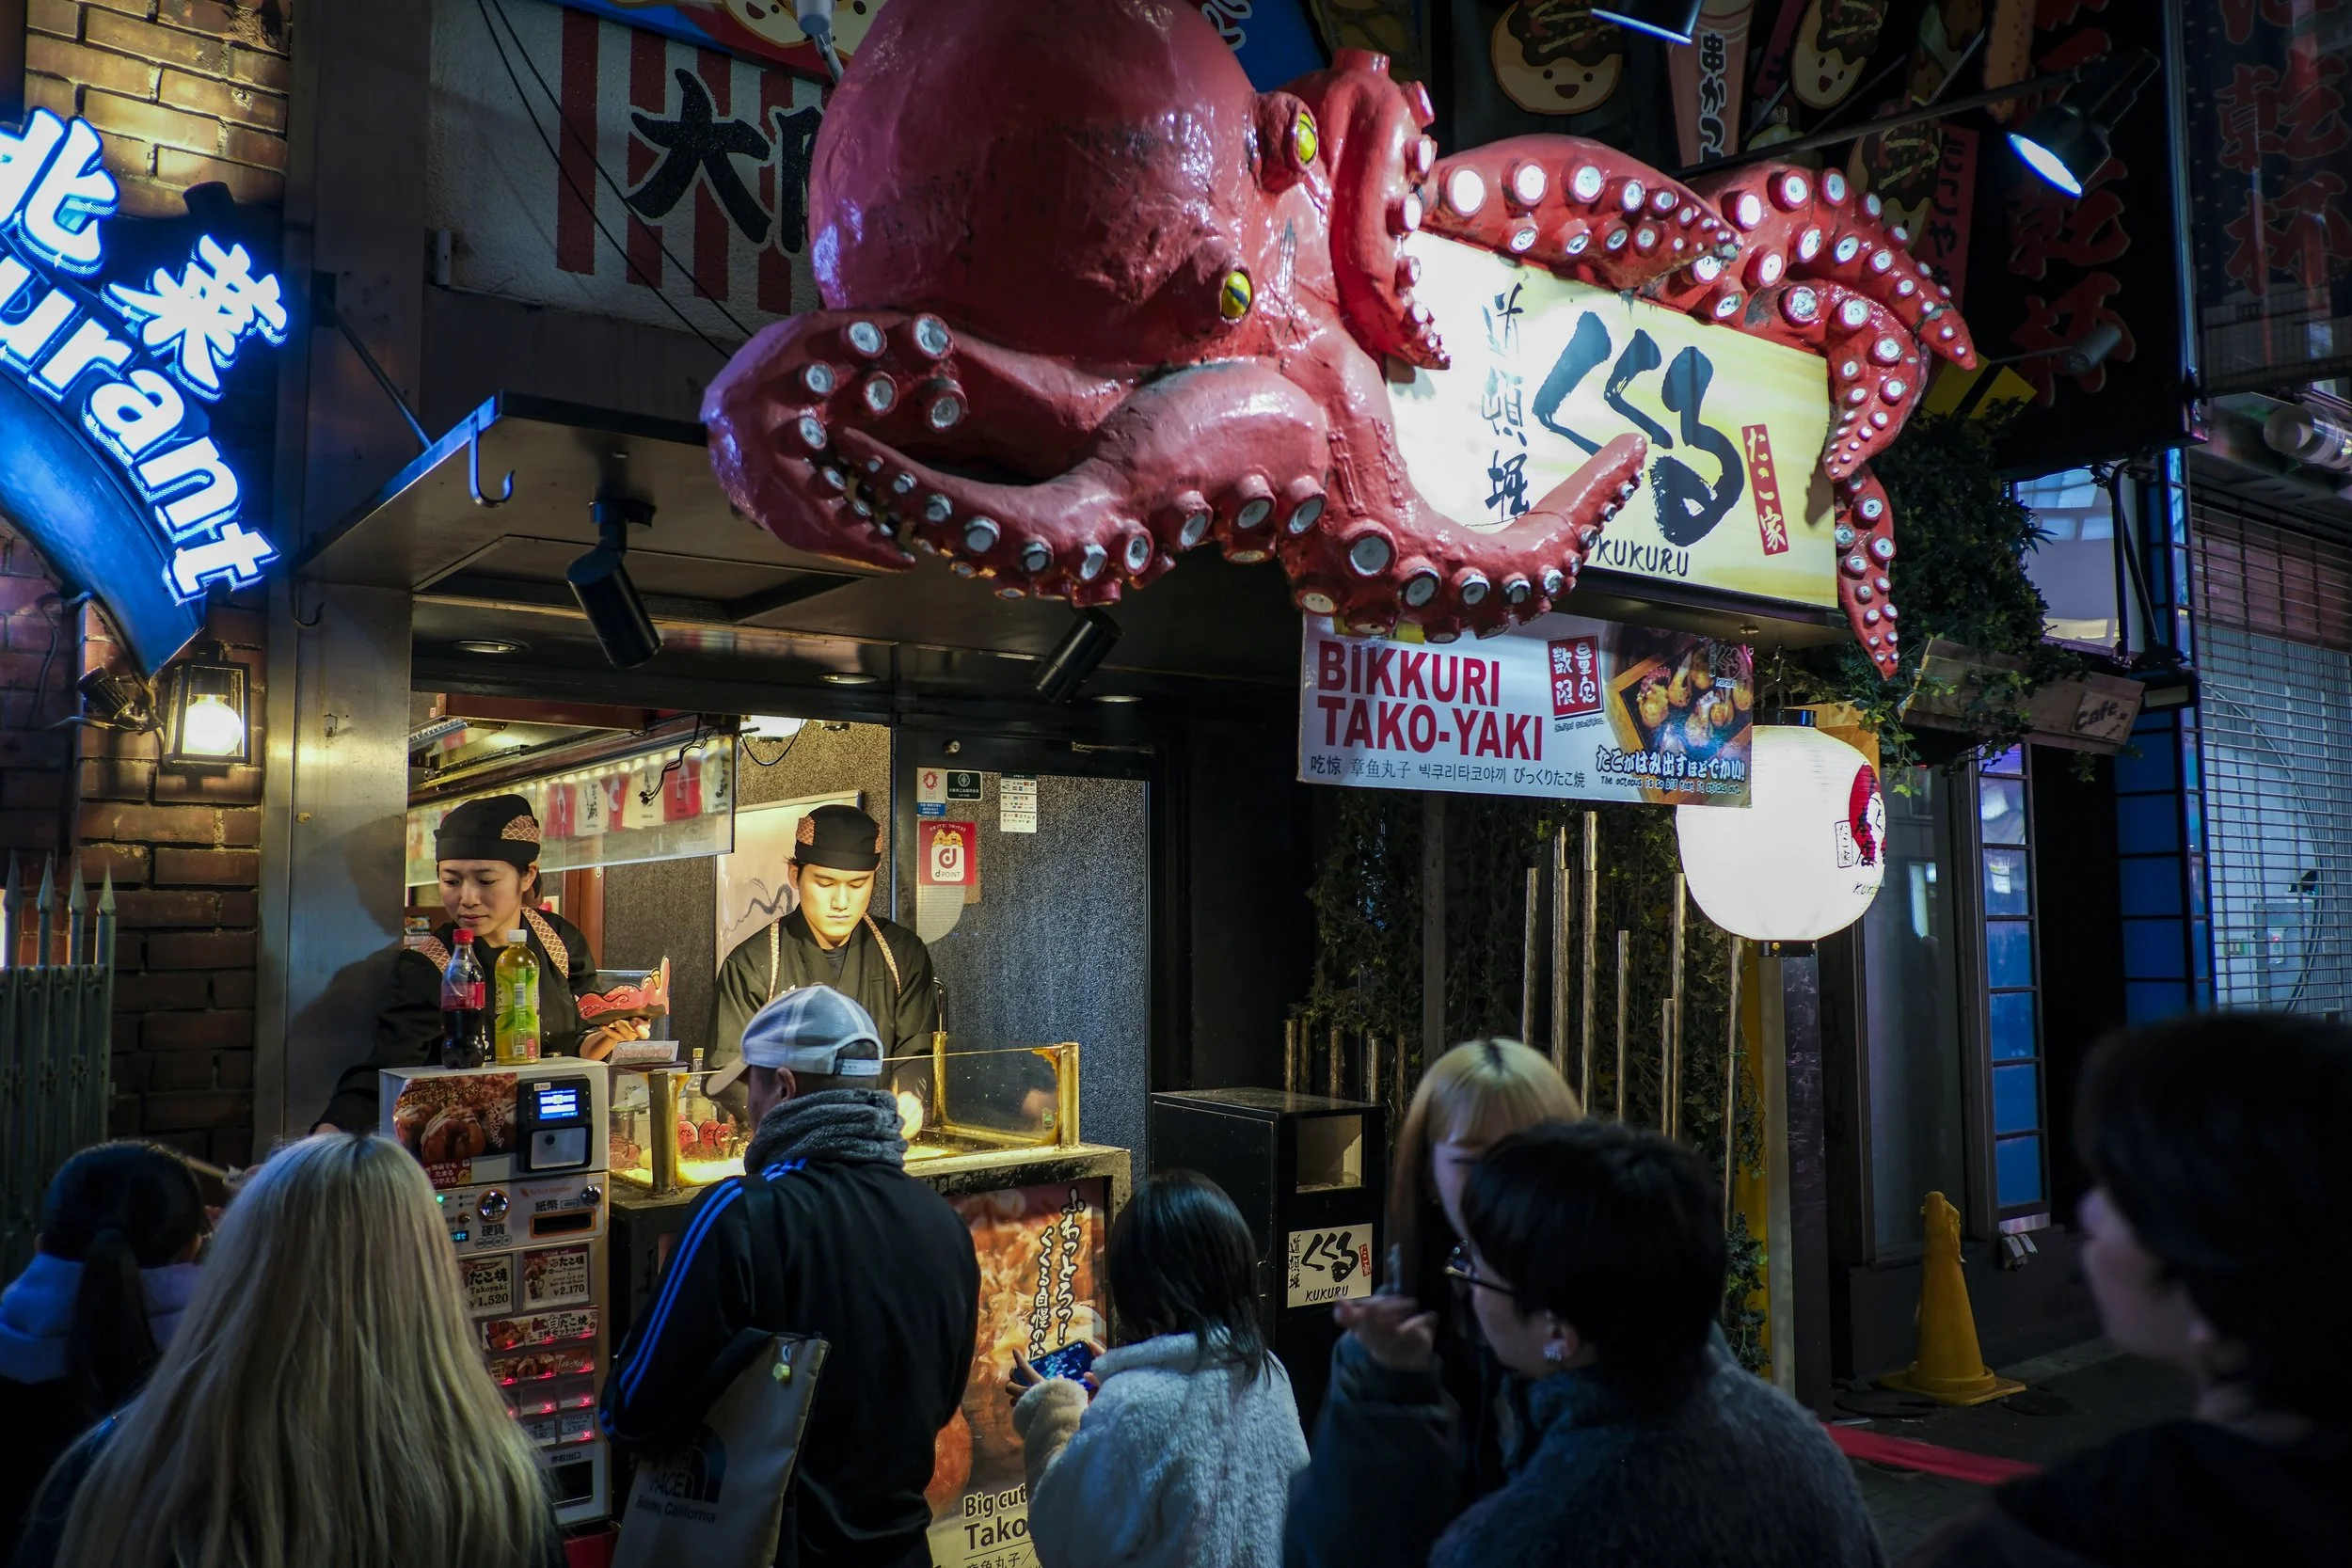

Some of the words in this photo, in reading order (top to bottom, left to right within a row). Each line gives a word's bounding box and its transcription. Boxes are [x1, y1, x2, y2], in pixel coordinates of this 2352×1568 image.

[1533, 310, 1745, 547] くくる
[1596, 534, 1690, 578] KUKURU
[1318, 640, 1501, 707] BIKKURI
[1317, 695, 1544, 762] TAKO-YAKI
[2074, 700, 2119, 731] Cafe
[1310, 754, 1342, 777] 吃惊
[1513, 767, 1586, 788] びっくりたこ焼
[1600, 775, 1613, 785] The
[1615, 777, 1643, 789] octopus
[534, 1199, 558, 1212] 紙幣
[481, 1223, 506, 1237] 硬貨
[1301, 1230, 1359, 1283] くくる
[469, 1267, 509, 1285] たこ焼
[469, 1282, 507, 1294] Takoyaki
[1305, 1284, 1349, 1303] KUKURU
[664, 1500, 718, 1525] California
[964, 1493, 993, 1518] Big
[998, 1484, 1026, 1509] cut
[964, 1515, 1026, 1550] Tako
